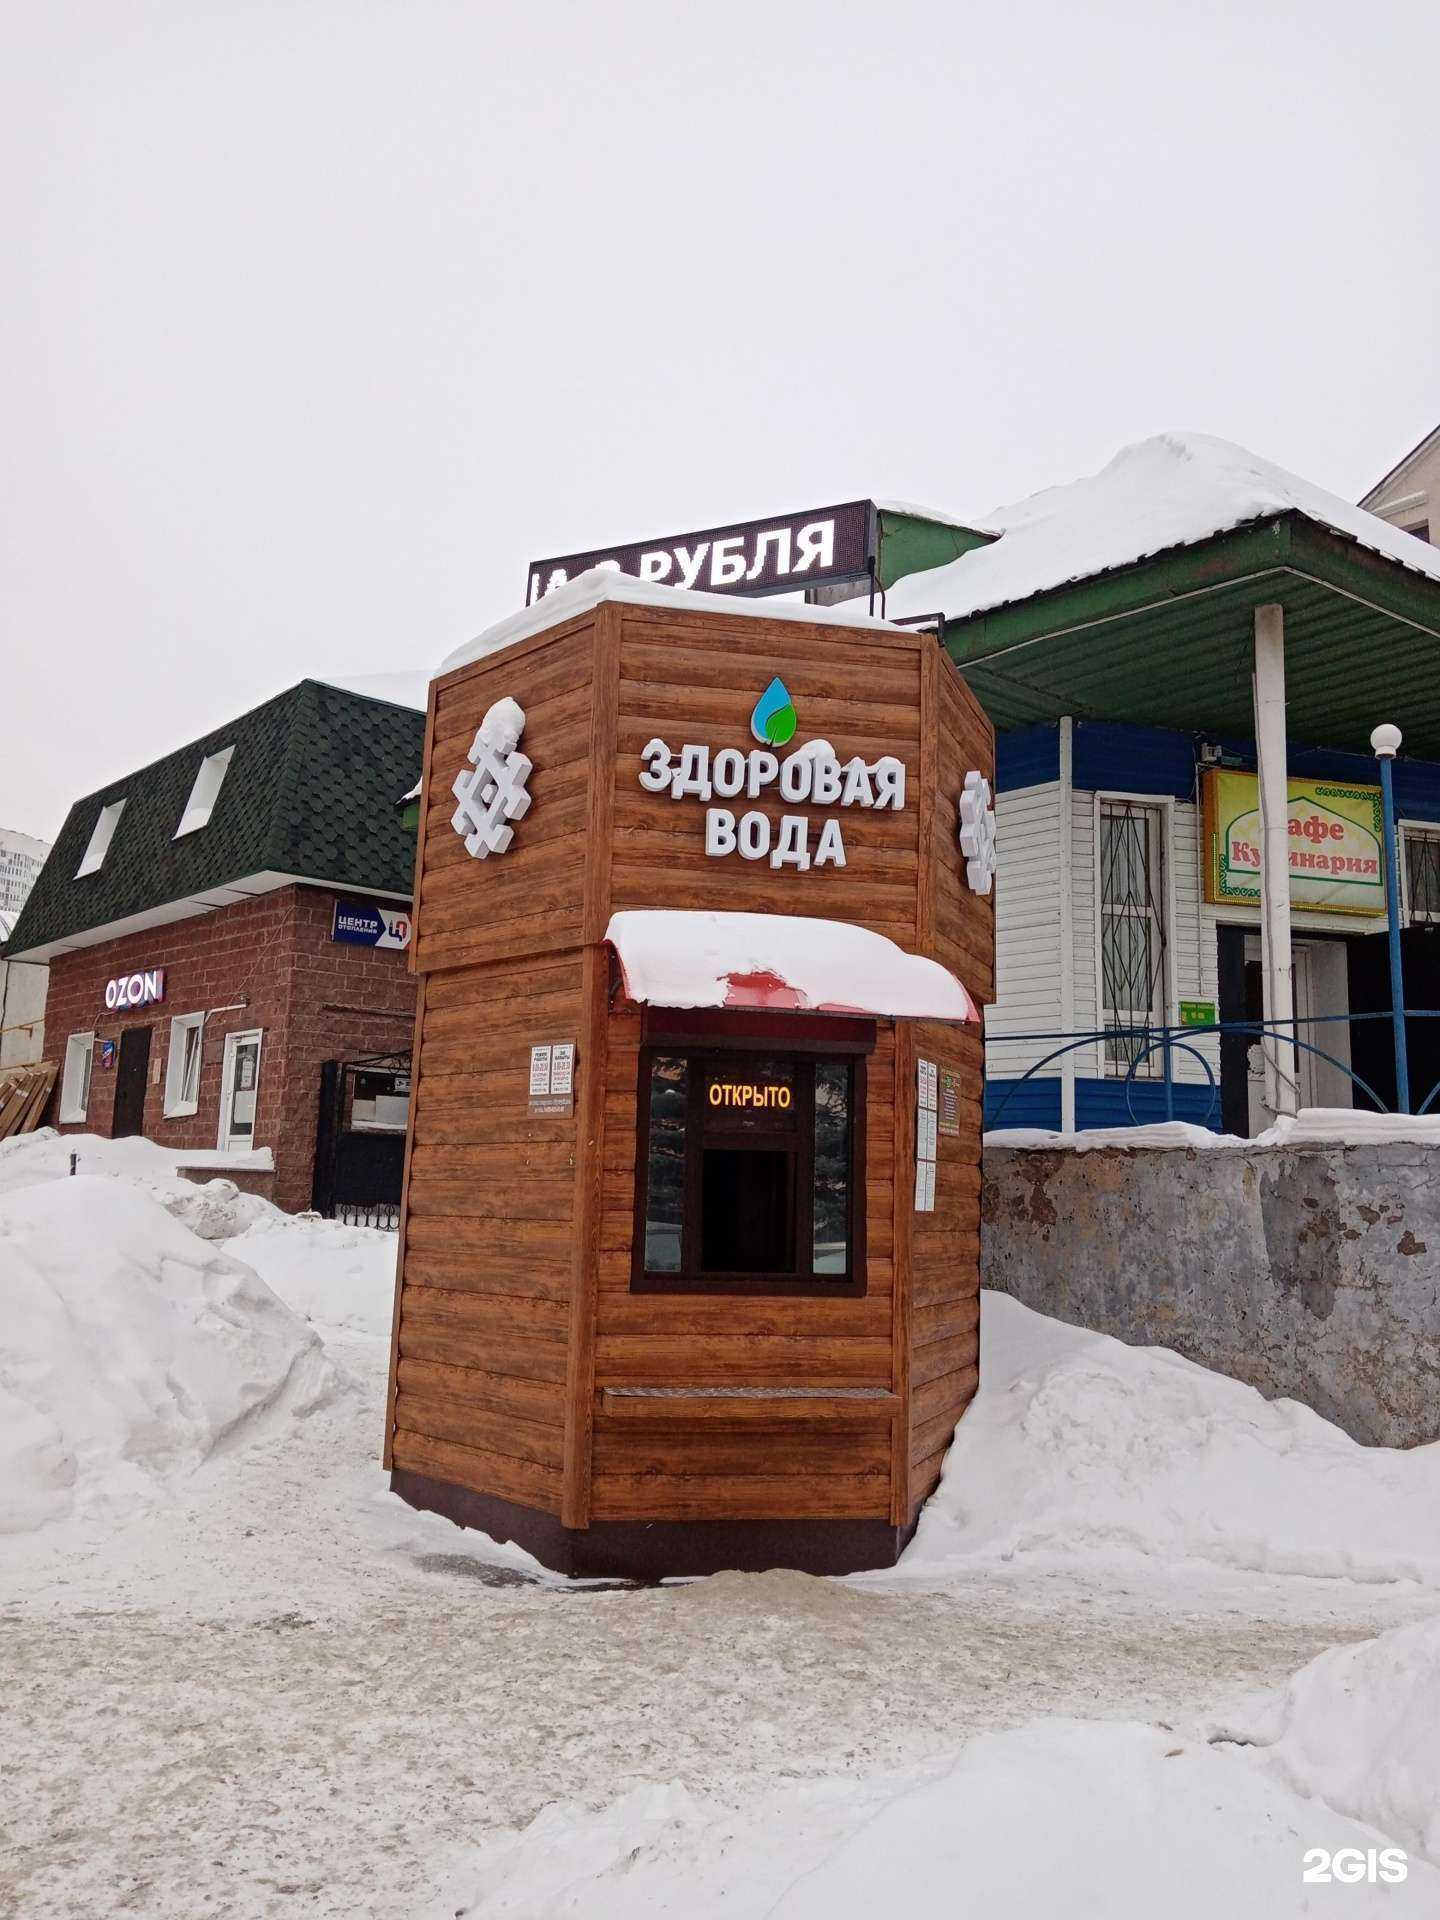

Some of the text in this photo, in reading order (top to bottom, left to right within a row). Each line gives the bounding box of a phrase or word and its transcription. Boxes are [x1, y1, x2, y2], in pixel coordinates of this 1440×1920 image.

[639, 519, 835, 590] РУБЛЯ
[639, 738, 906, 810] ЗДОРОВАЯ
[705, 808, 847, 871] ВОДА
[1288, 815, 1344, 844] афе
[1231, 841, 1378, 875] Куинария
[338, 915, 378, 929] ЦЕНТР
[105, 970, 157, 1009] OZON
[709, 1084, 791, 1108] ОТКРЫТО
